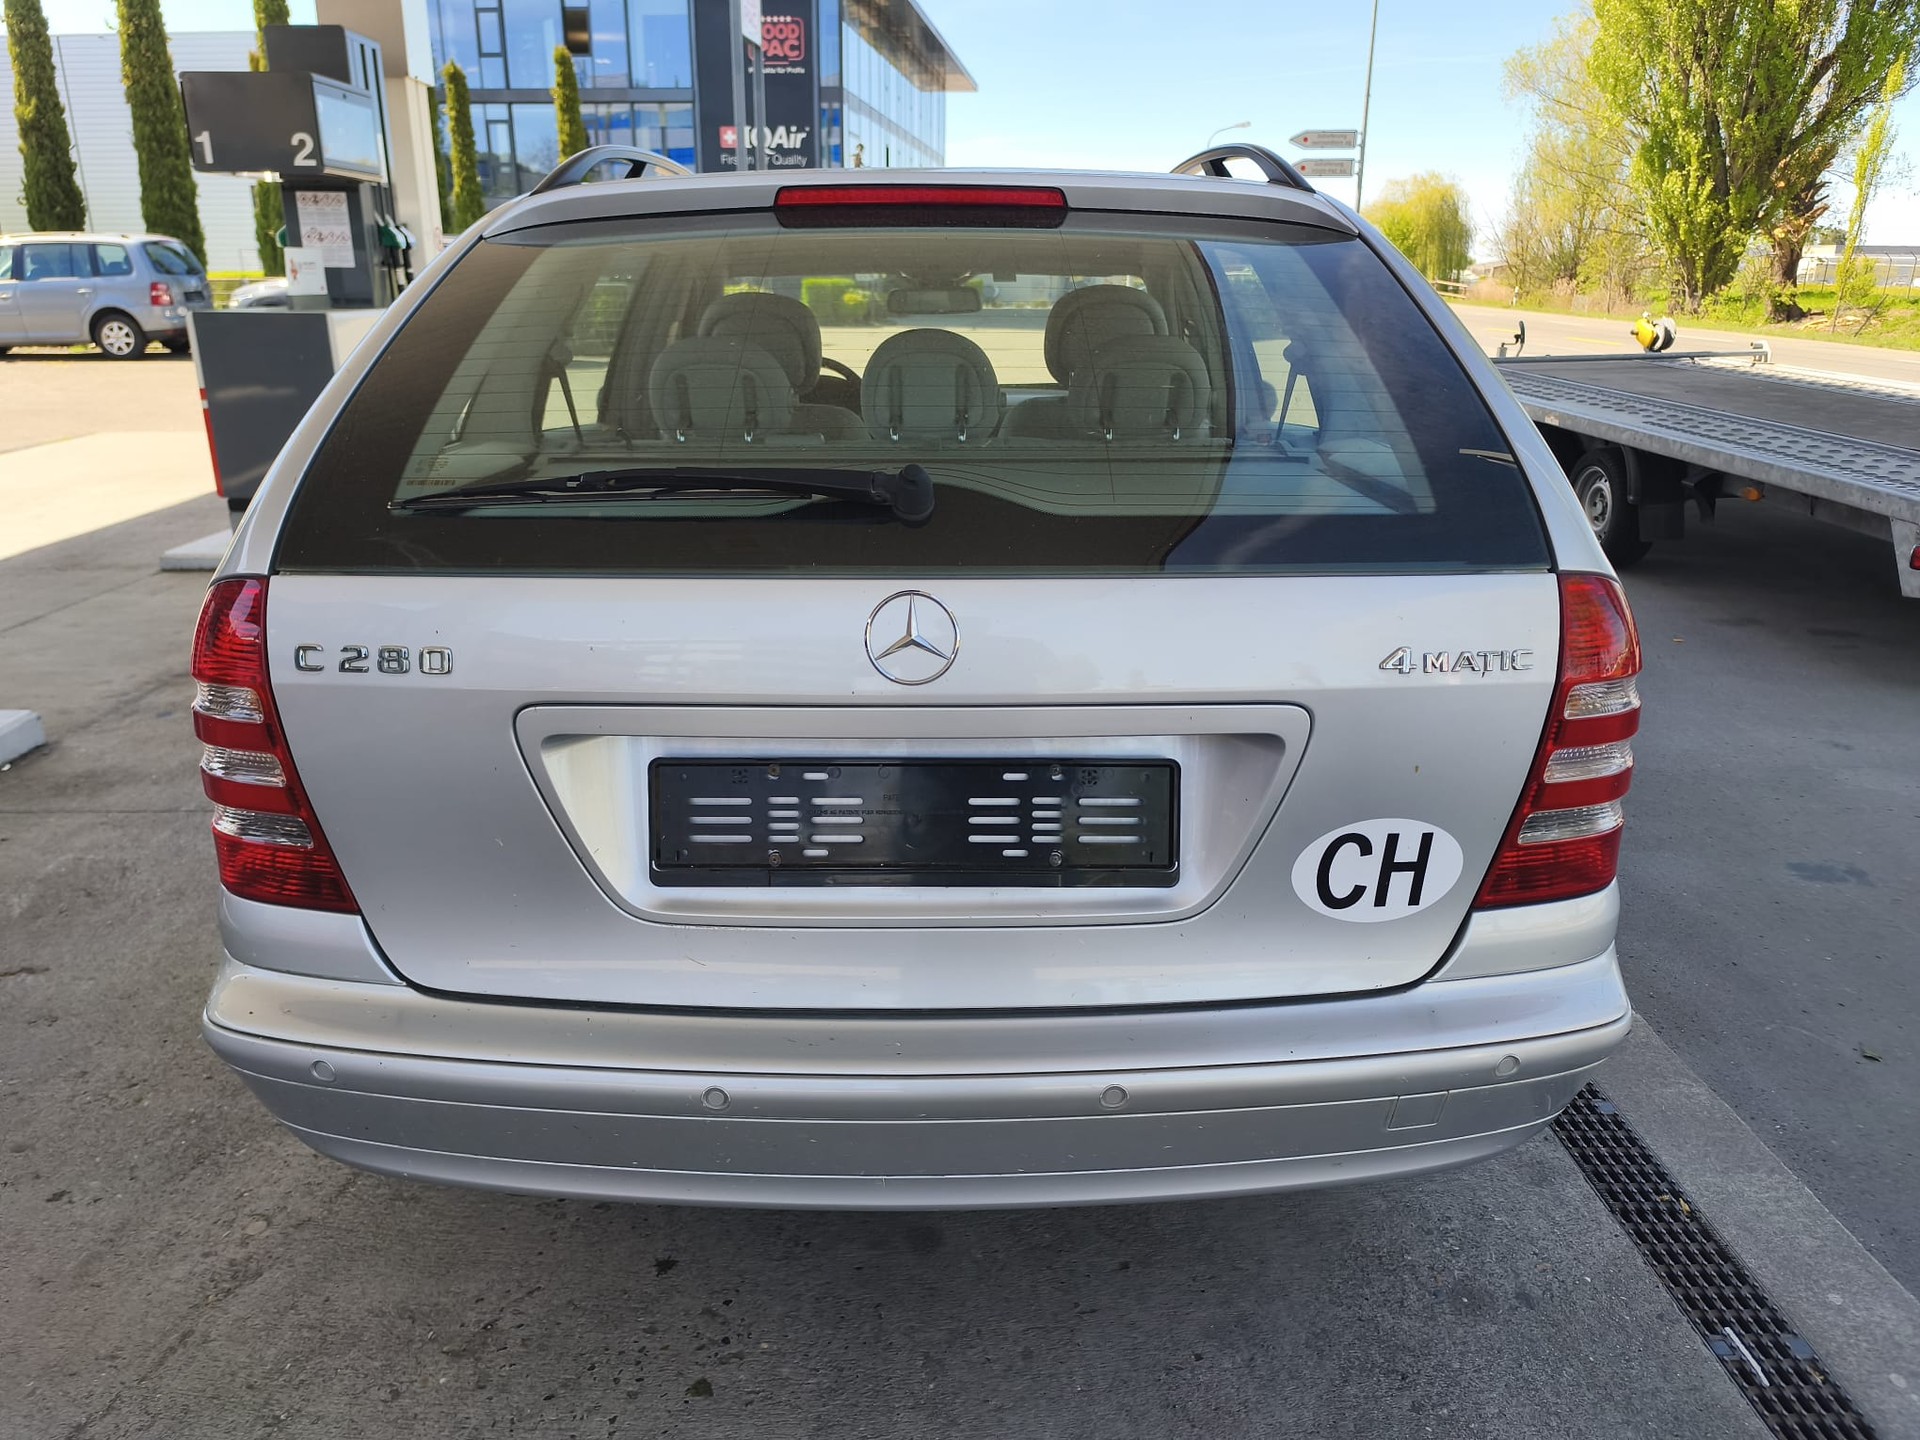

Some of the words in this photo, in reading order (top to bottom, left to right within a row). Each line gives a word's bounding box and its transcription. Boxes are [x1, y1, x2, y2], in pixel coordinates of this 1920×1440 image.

[195, 130, 214, 164] 1
[290, 132, 317, 166] 2
[720, 154, 737, 165] Firs
[772, 153, 808, 167] Quality
[294, 643, 325, 672] C
[338, 644, 454, 675] 280
[1316, 832, 1434, 910] CH
